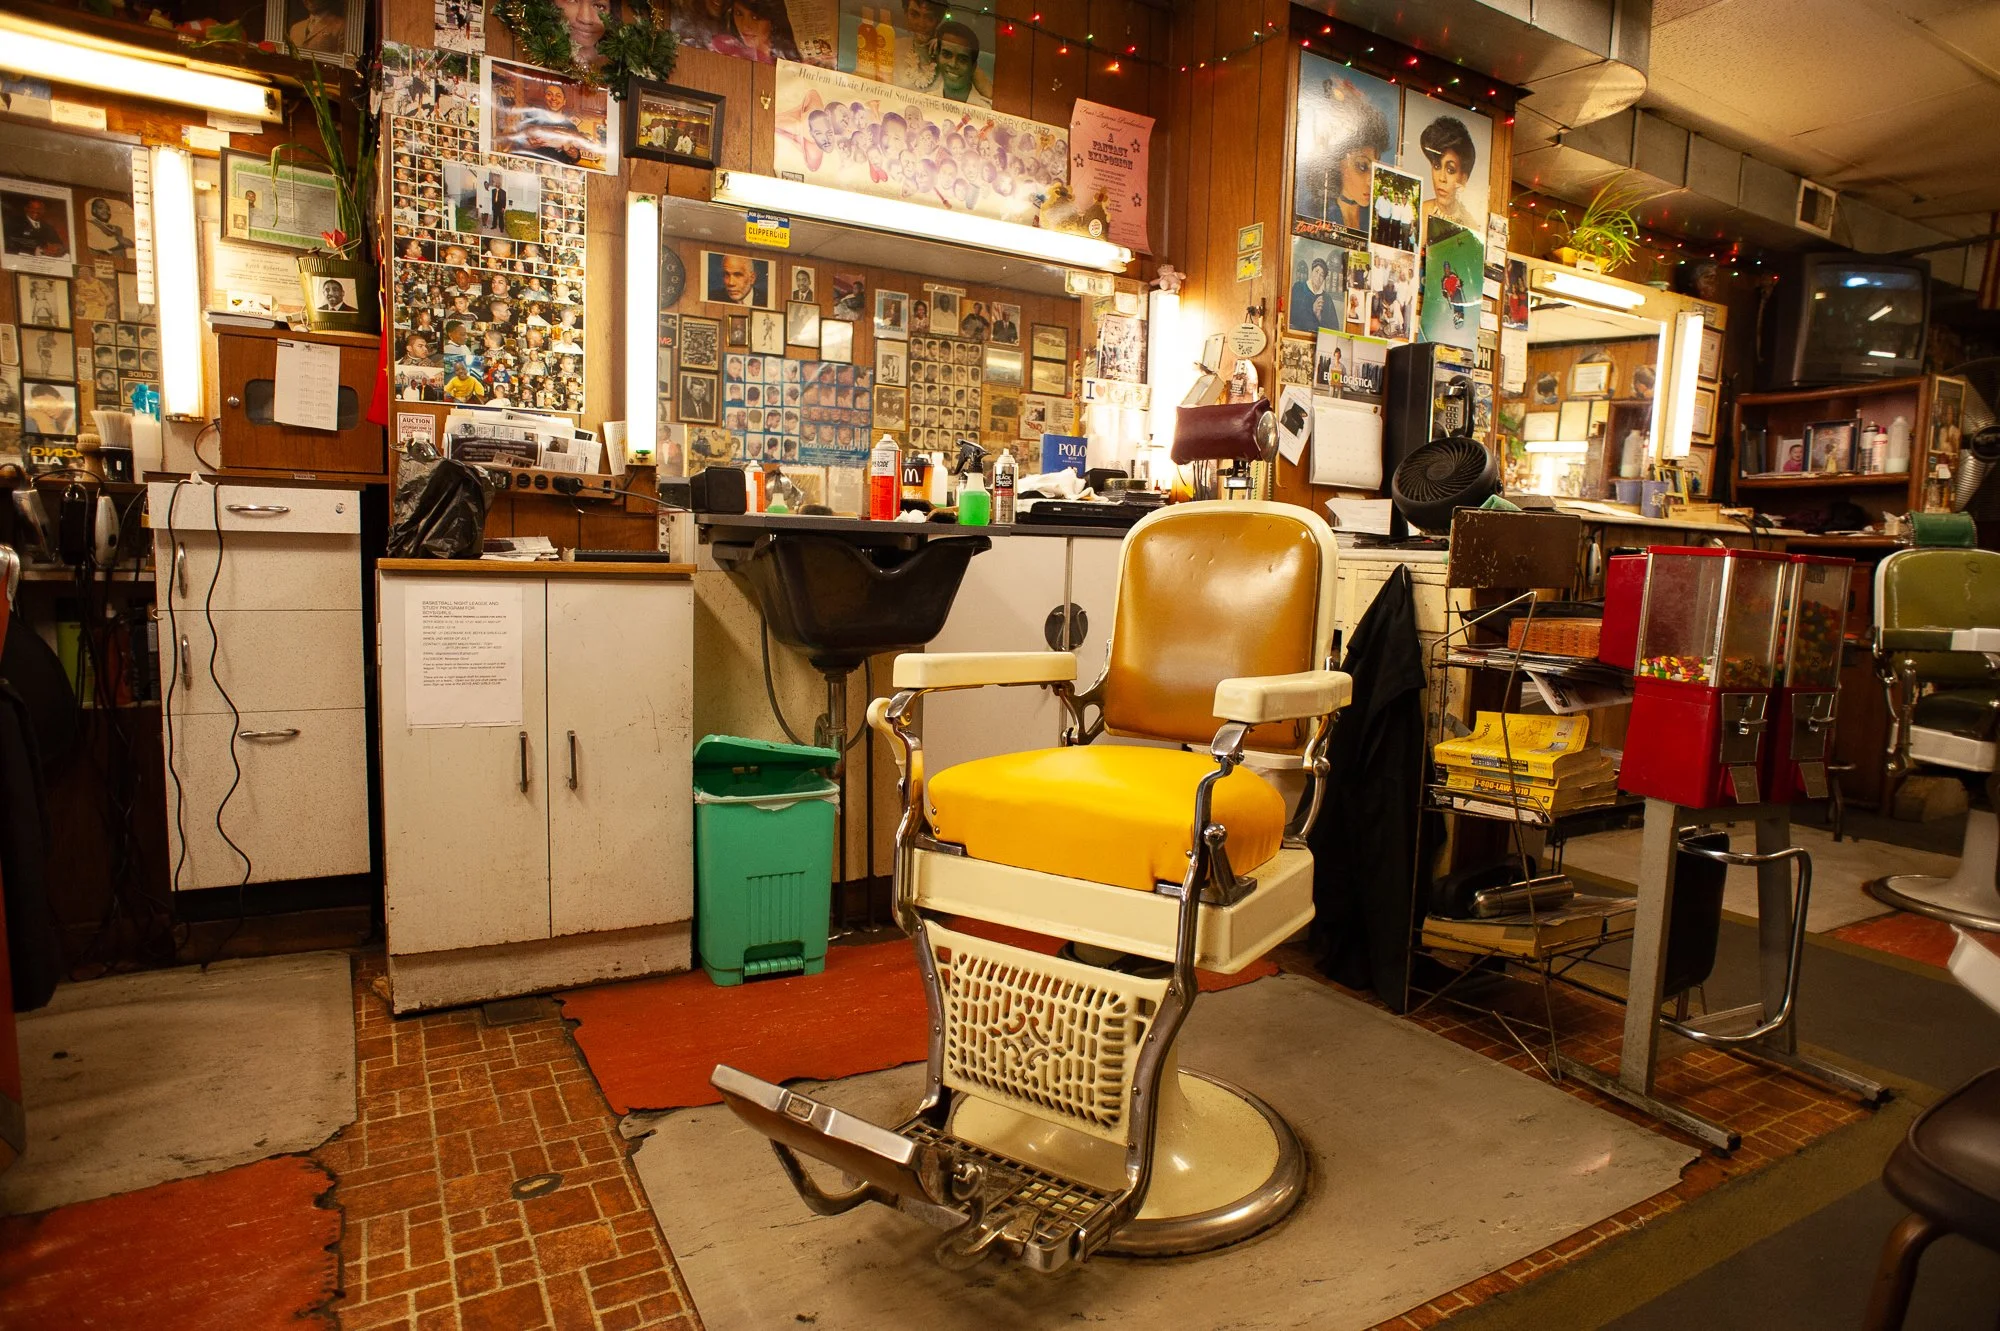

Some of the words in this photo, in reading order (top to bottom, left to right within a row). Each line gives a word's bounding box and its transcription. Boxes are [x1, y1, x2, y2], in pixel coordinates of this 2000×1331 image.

[800, 67, 831, 84] Harlem
[834, 78, 859, 90] Music
[860, 81, 892, 98] Festival
[925, 98, 939, 108] THE
[942, 102, 960, 115] 100th
[962, 106, 1020, 128] ANNIVERSARY
[1021, 122, 1033, 132] OF
[1034, 124, 1050, 136] JAZZ
[1108, 132, 1114, 143] A
[1092, 140, 1128, 158] FANTASY
[1086, 380, 1095, 399] I
[1058, 443, 1086, 458] POLO
[1476, 780, 1529, 796] 1-800-LAW-010
